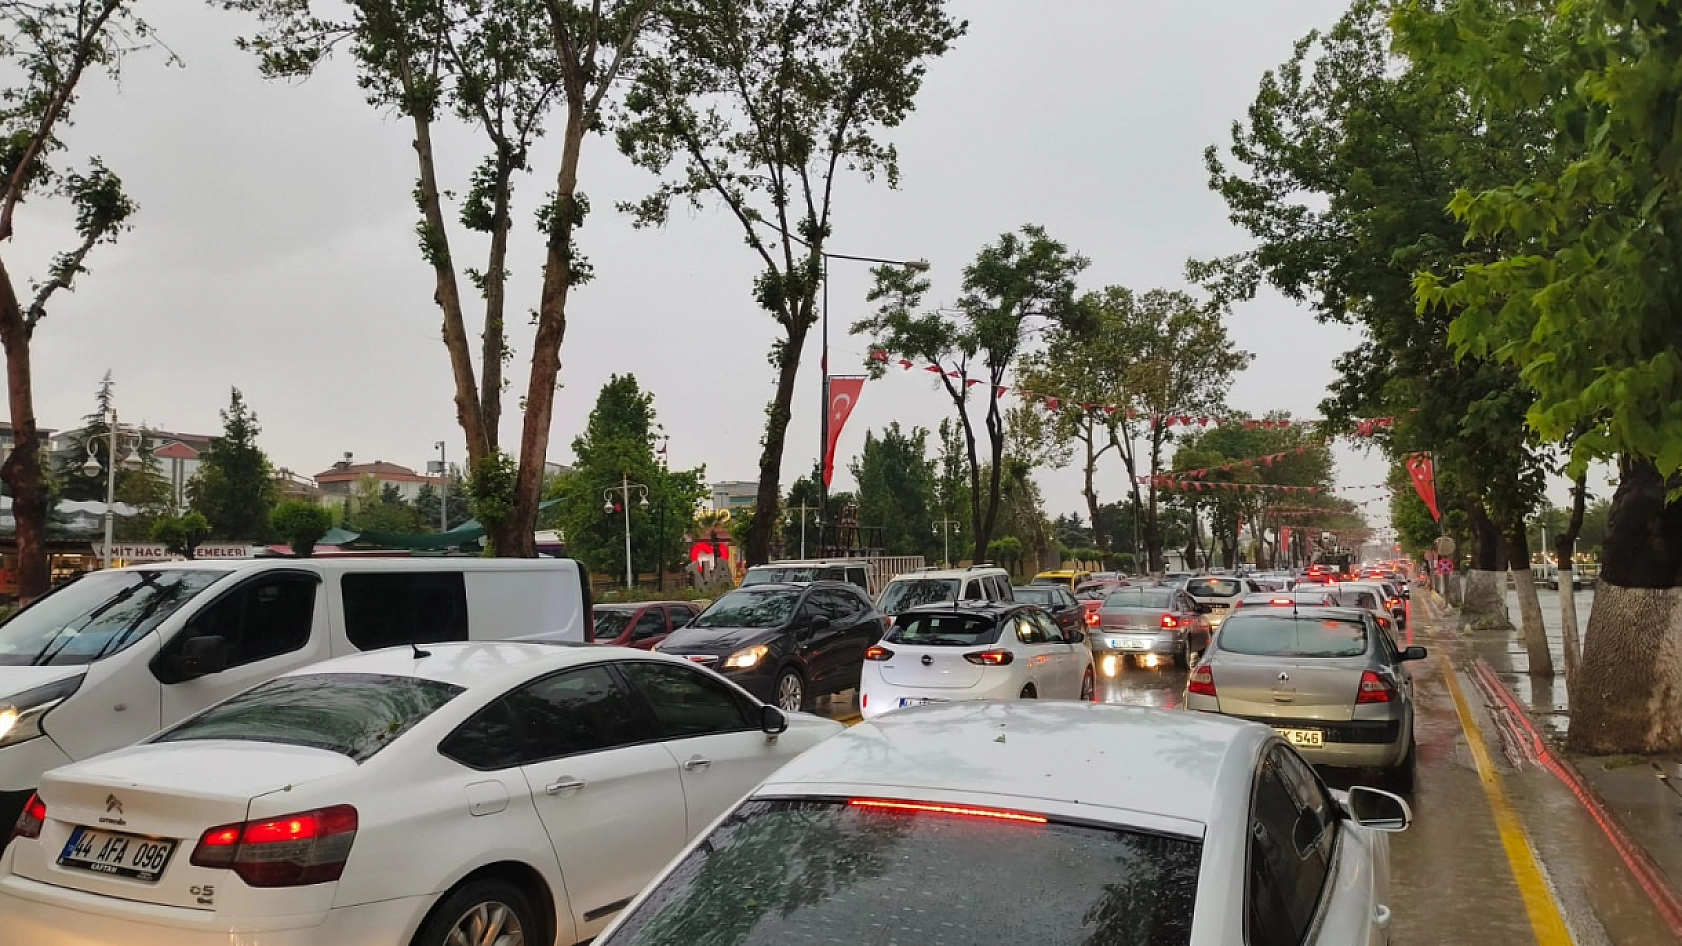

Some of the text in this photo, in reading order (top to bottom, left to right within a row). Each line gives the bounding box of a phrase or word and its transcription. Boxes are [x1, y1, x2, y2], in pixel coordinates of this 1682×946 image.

[135, 546, 162, 557] HAC
[164, 545, 246, 557] MEMELERİ
[1295, 731, 1318, 743] 546
[75, 833, 168, 870] 44 AFA 096
[189, 884, 215, 896] C5
